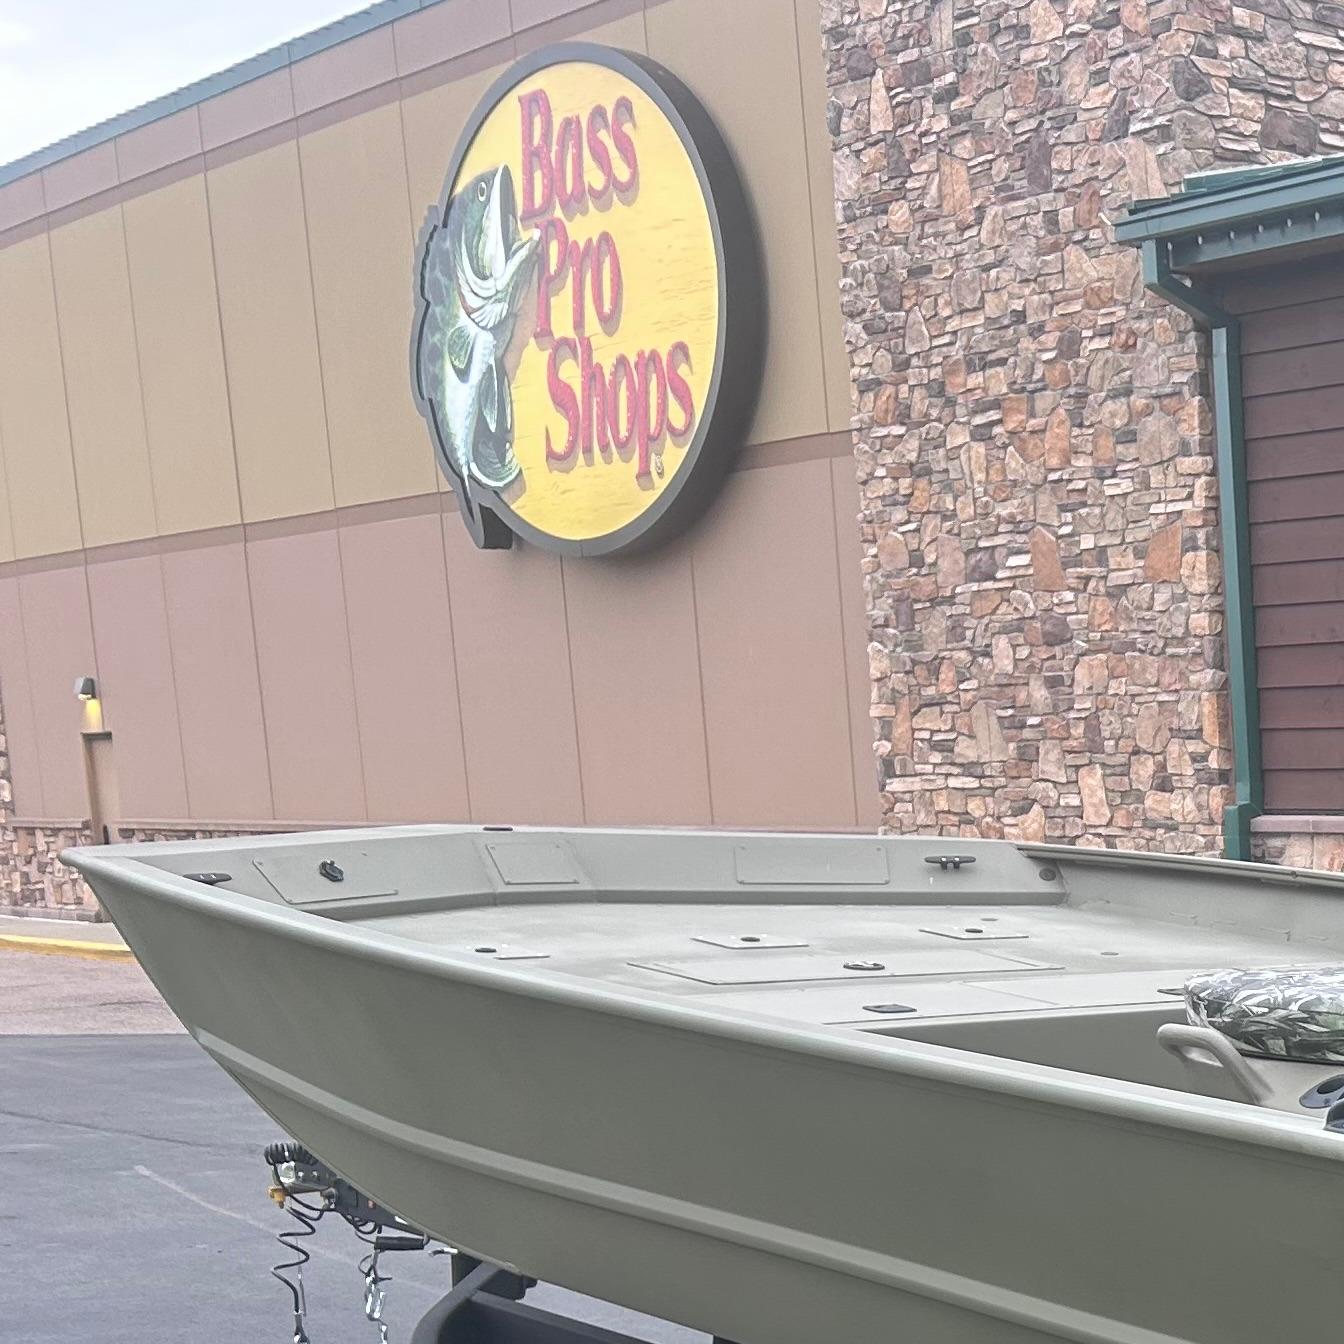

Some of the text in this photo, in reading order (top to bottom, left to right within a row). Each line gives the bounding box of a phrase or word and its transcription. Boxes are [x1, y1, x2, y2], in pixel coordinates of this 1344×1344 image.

[517, 87, 638, 222] Bass
[536, 219, 623, 339] Pro
[544, 336, 696, 477] Shops
